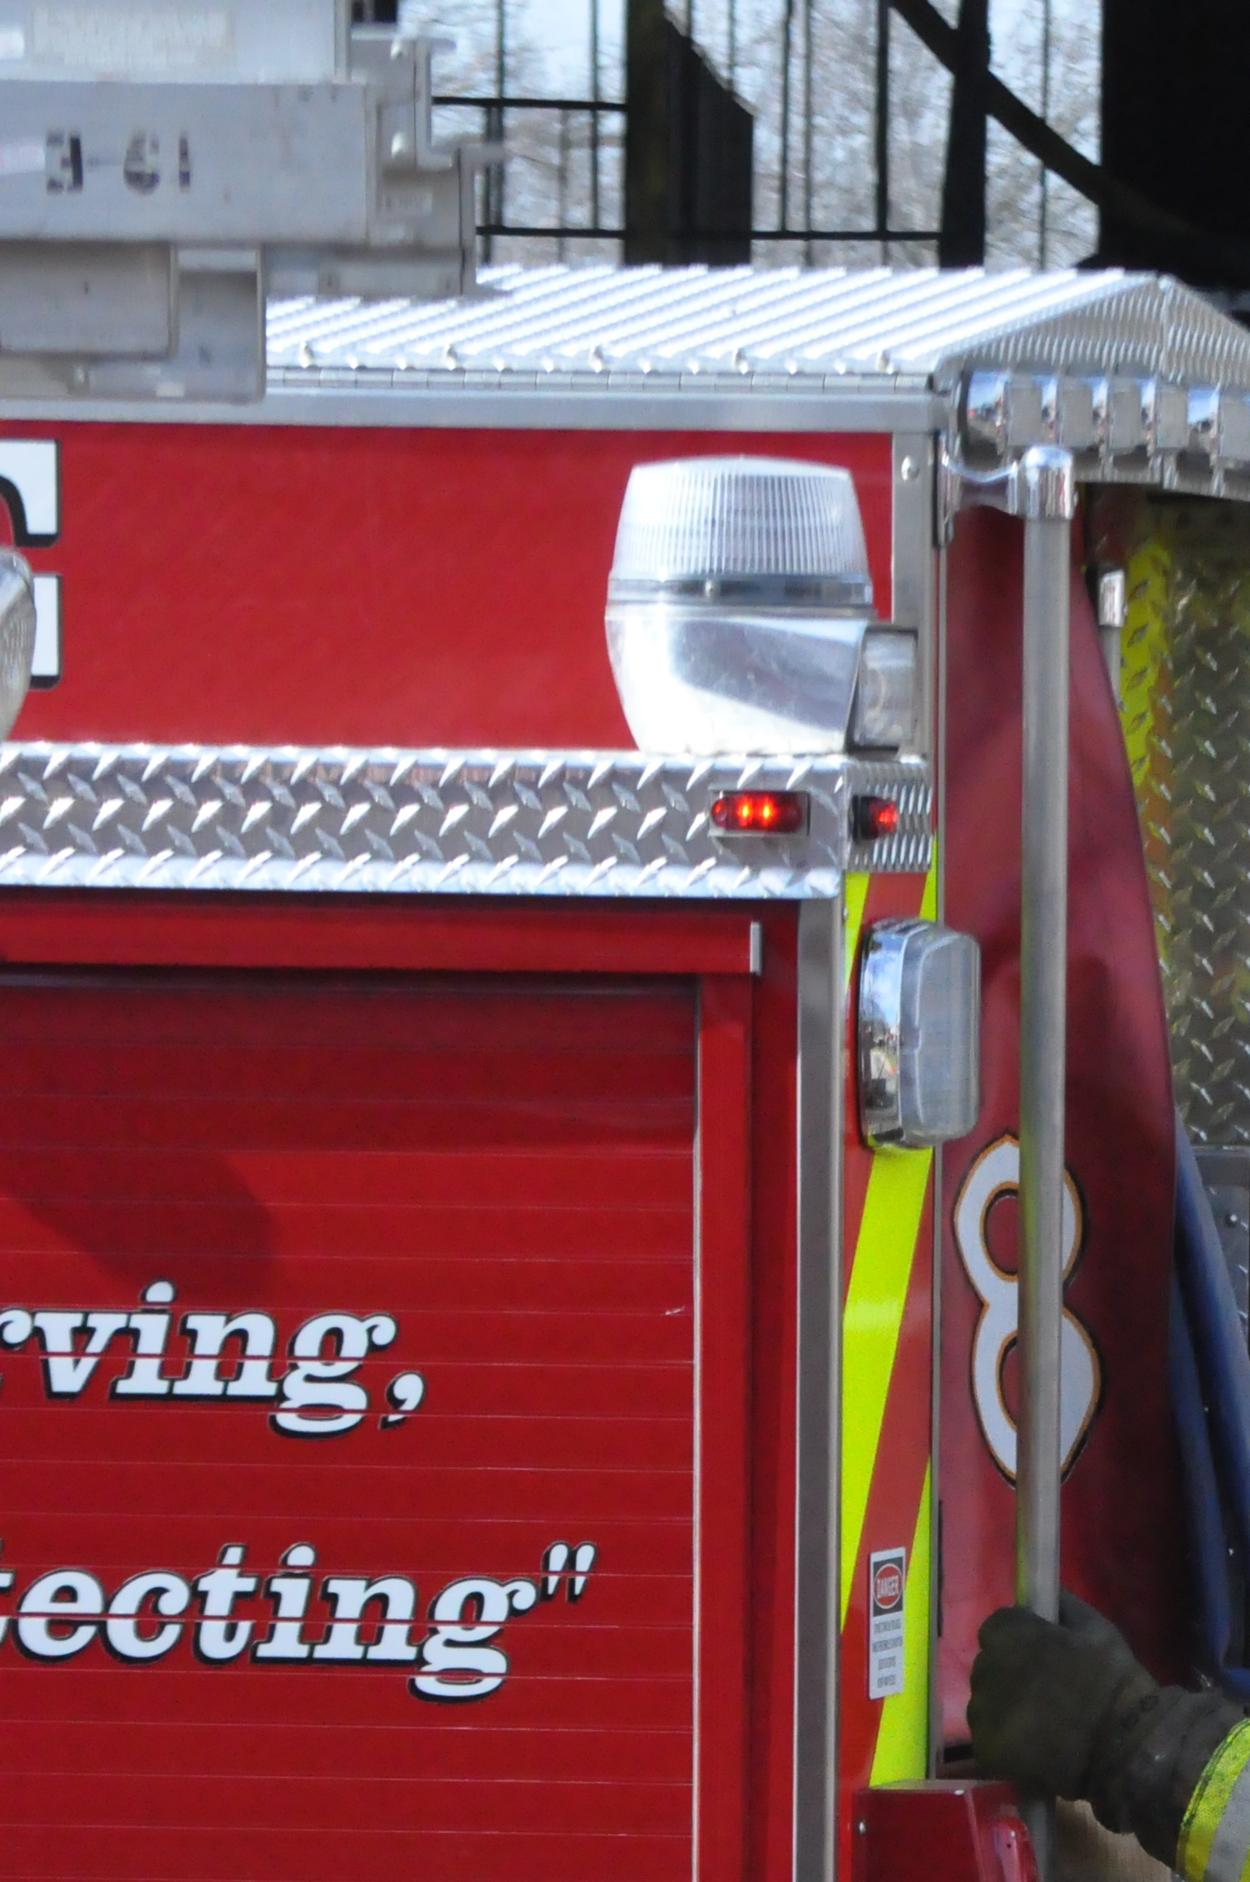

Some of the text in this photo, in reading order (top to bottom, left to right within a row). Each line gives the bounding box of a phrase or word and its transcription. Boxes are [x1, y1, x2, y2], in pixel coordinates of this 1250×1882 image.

[954, 1130, 1105, 1488] 8
[0, 1541, 597, 1700] ecting"
[876, 1574, 900, 1600] DANGER
